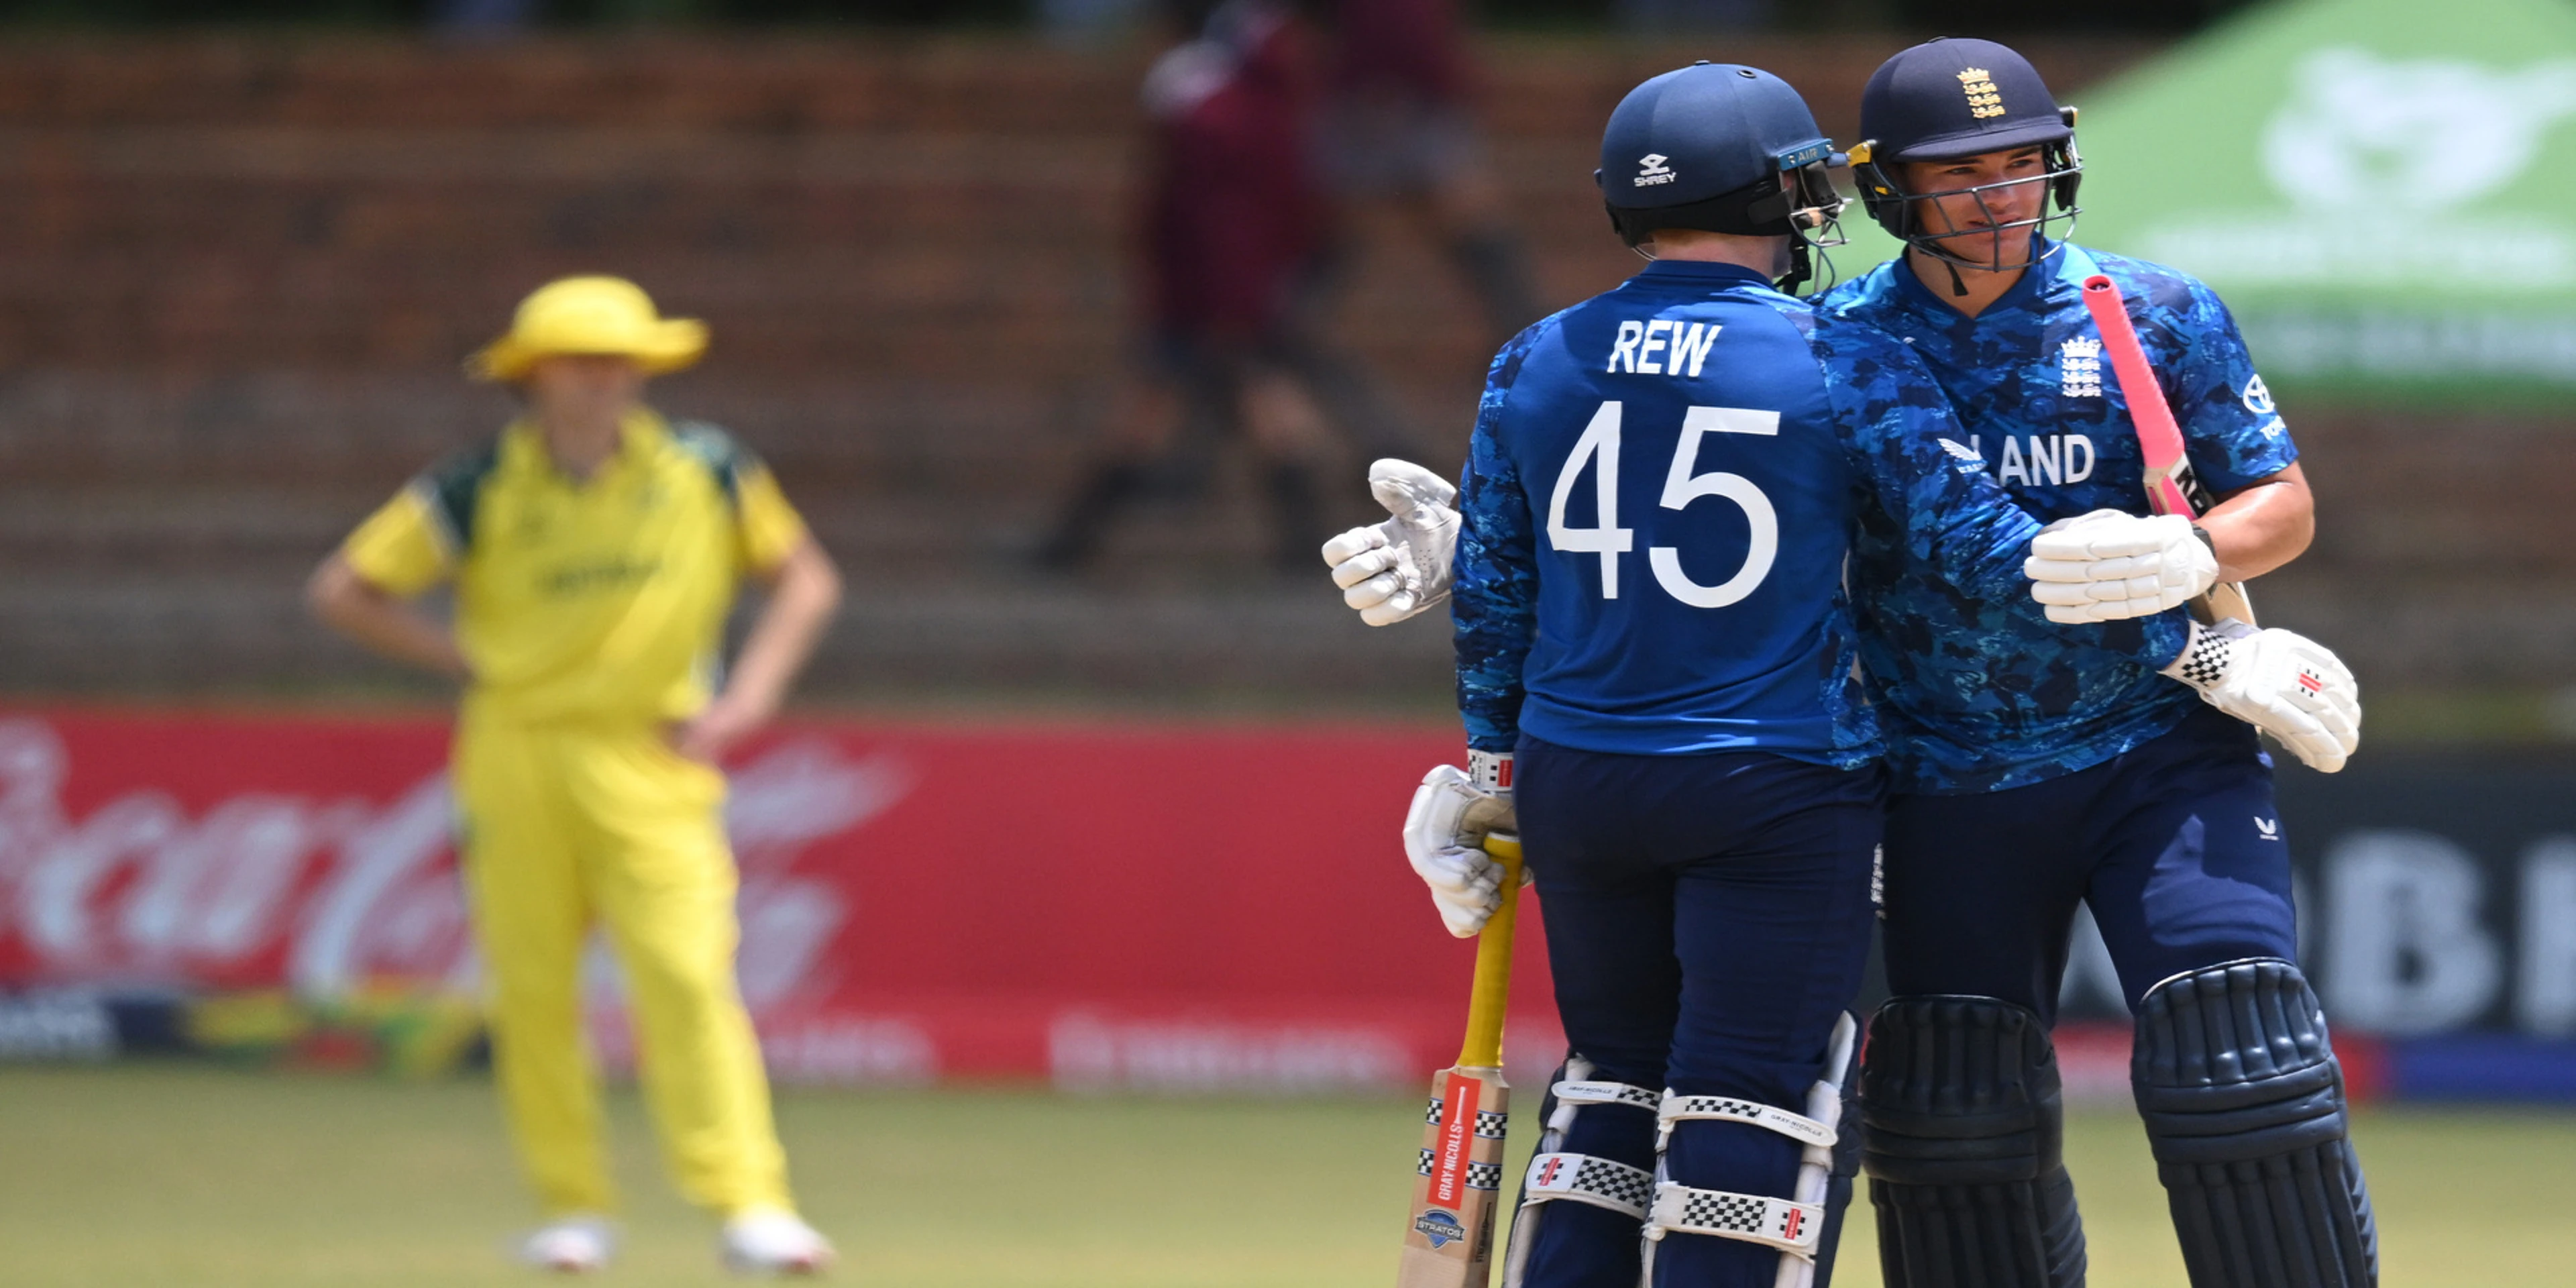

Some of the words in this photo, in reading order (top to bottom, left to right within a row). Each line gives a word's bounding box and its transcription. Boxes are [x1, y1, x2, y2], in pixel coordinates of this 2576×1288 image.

[1634, 172, 1676, 187] SHREY
[1607, 320, 1723, 376] REW
[1547, 400, 1780, 608] 45
[1418, 1220, 1460, 1238] STRATOS
